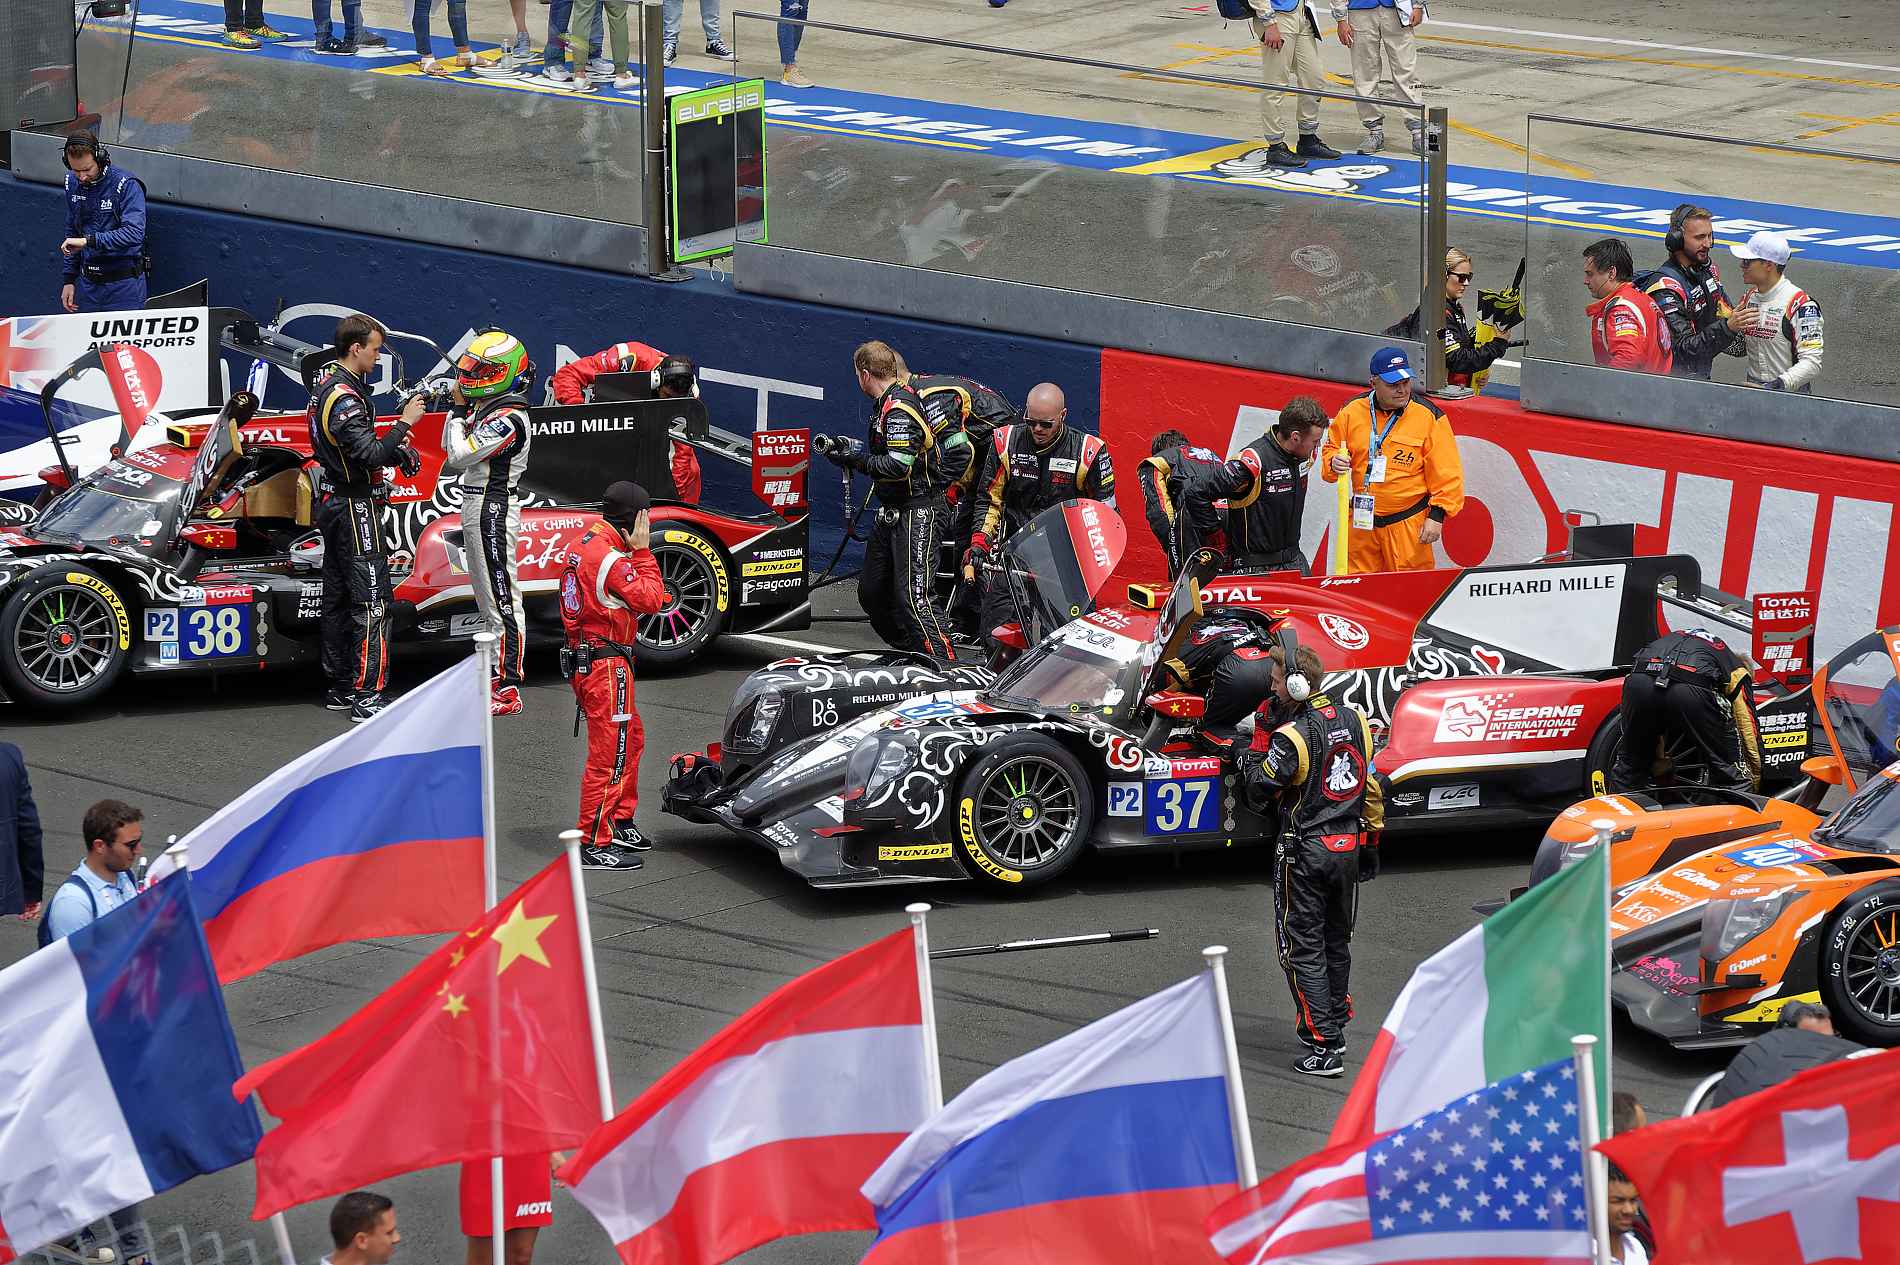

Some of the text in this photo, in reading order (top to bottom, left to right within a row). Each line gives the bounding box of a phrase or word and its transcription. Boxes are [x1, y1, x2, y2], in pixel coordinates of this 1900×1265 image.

[679, 92, 760, 121] eurasia
[90, 316, 199, 338] UNITED
[581, 417, 634, 432] MILLE
[758, 434, 805, 445] TOTAL
[758, 444, 805, 456] 道达尔
[686, 533, 728, 603] DUNLOP
[754, 561, 801, 573] DUNLOP
[207, 587, 251, 599] TOTAL
[1200, 586, 1262, 603] OTAL
[1469, 575, 1615, 597] RICHARD MILLE
[1757, 596, 1811, 607] TOTAL
[86, 577, 130, 644] DUNLOP
[1757, 607, 1810, 620] 道达尔
[147, 612, 175, 637] P2
[188, 607, 242, 657] 38
[162, 644, 177, 658] M
[852, 692, 896, 704] RICHARD
[1493, 704, 1585, 721] SEPANG
[1489, 718, 1578, 731] INTERNATIONAL
[1485, 727, 1576, 742] CIRCUIT
[1172, 760, 1218, 771] TOTAL
[1110, 786, 1140, 812] P2
[1155, 780, 1211, 832] 37
[773, 820, 801, 844] TOTAL
[961, 807, 1005, 877] DUNLOP
[891, 847, 950, 858] DUNLOP
[1740, 847, 1803, 867] 40
